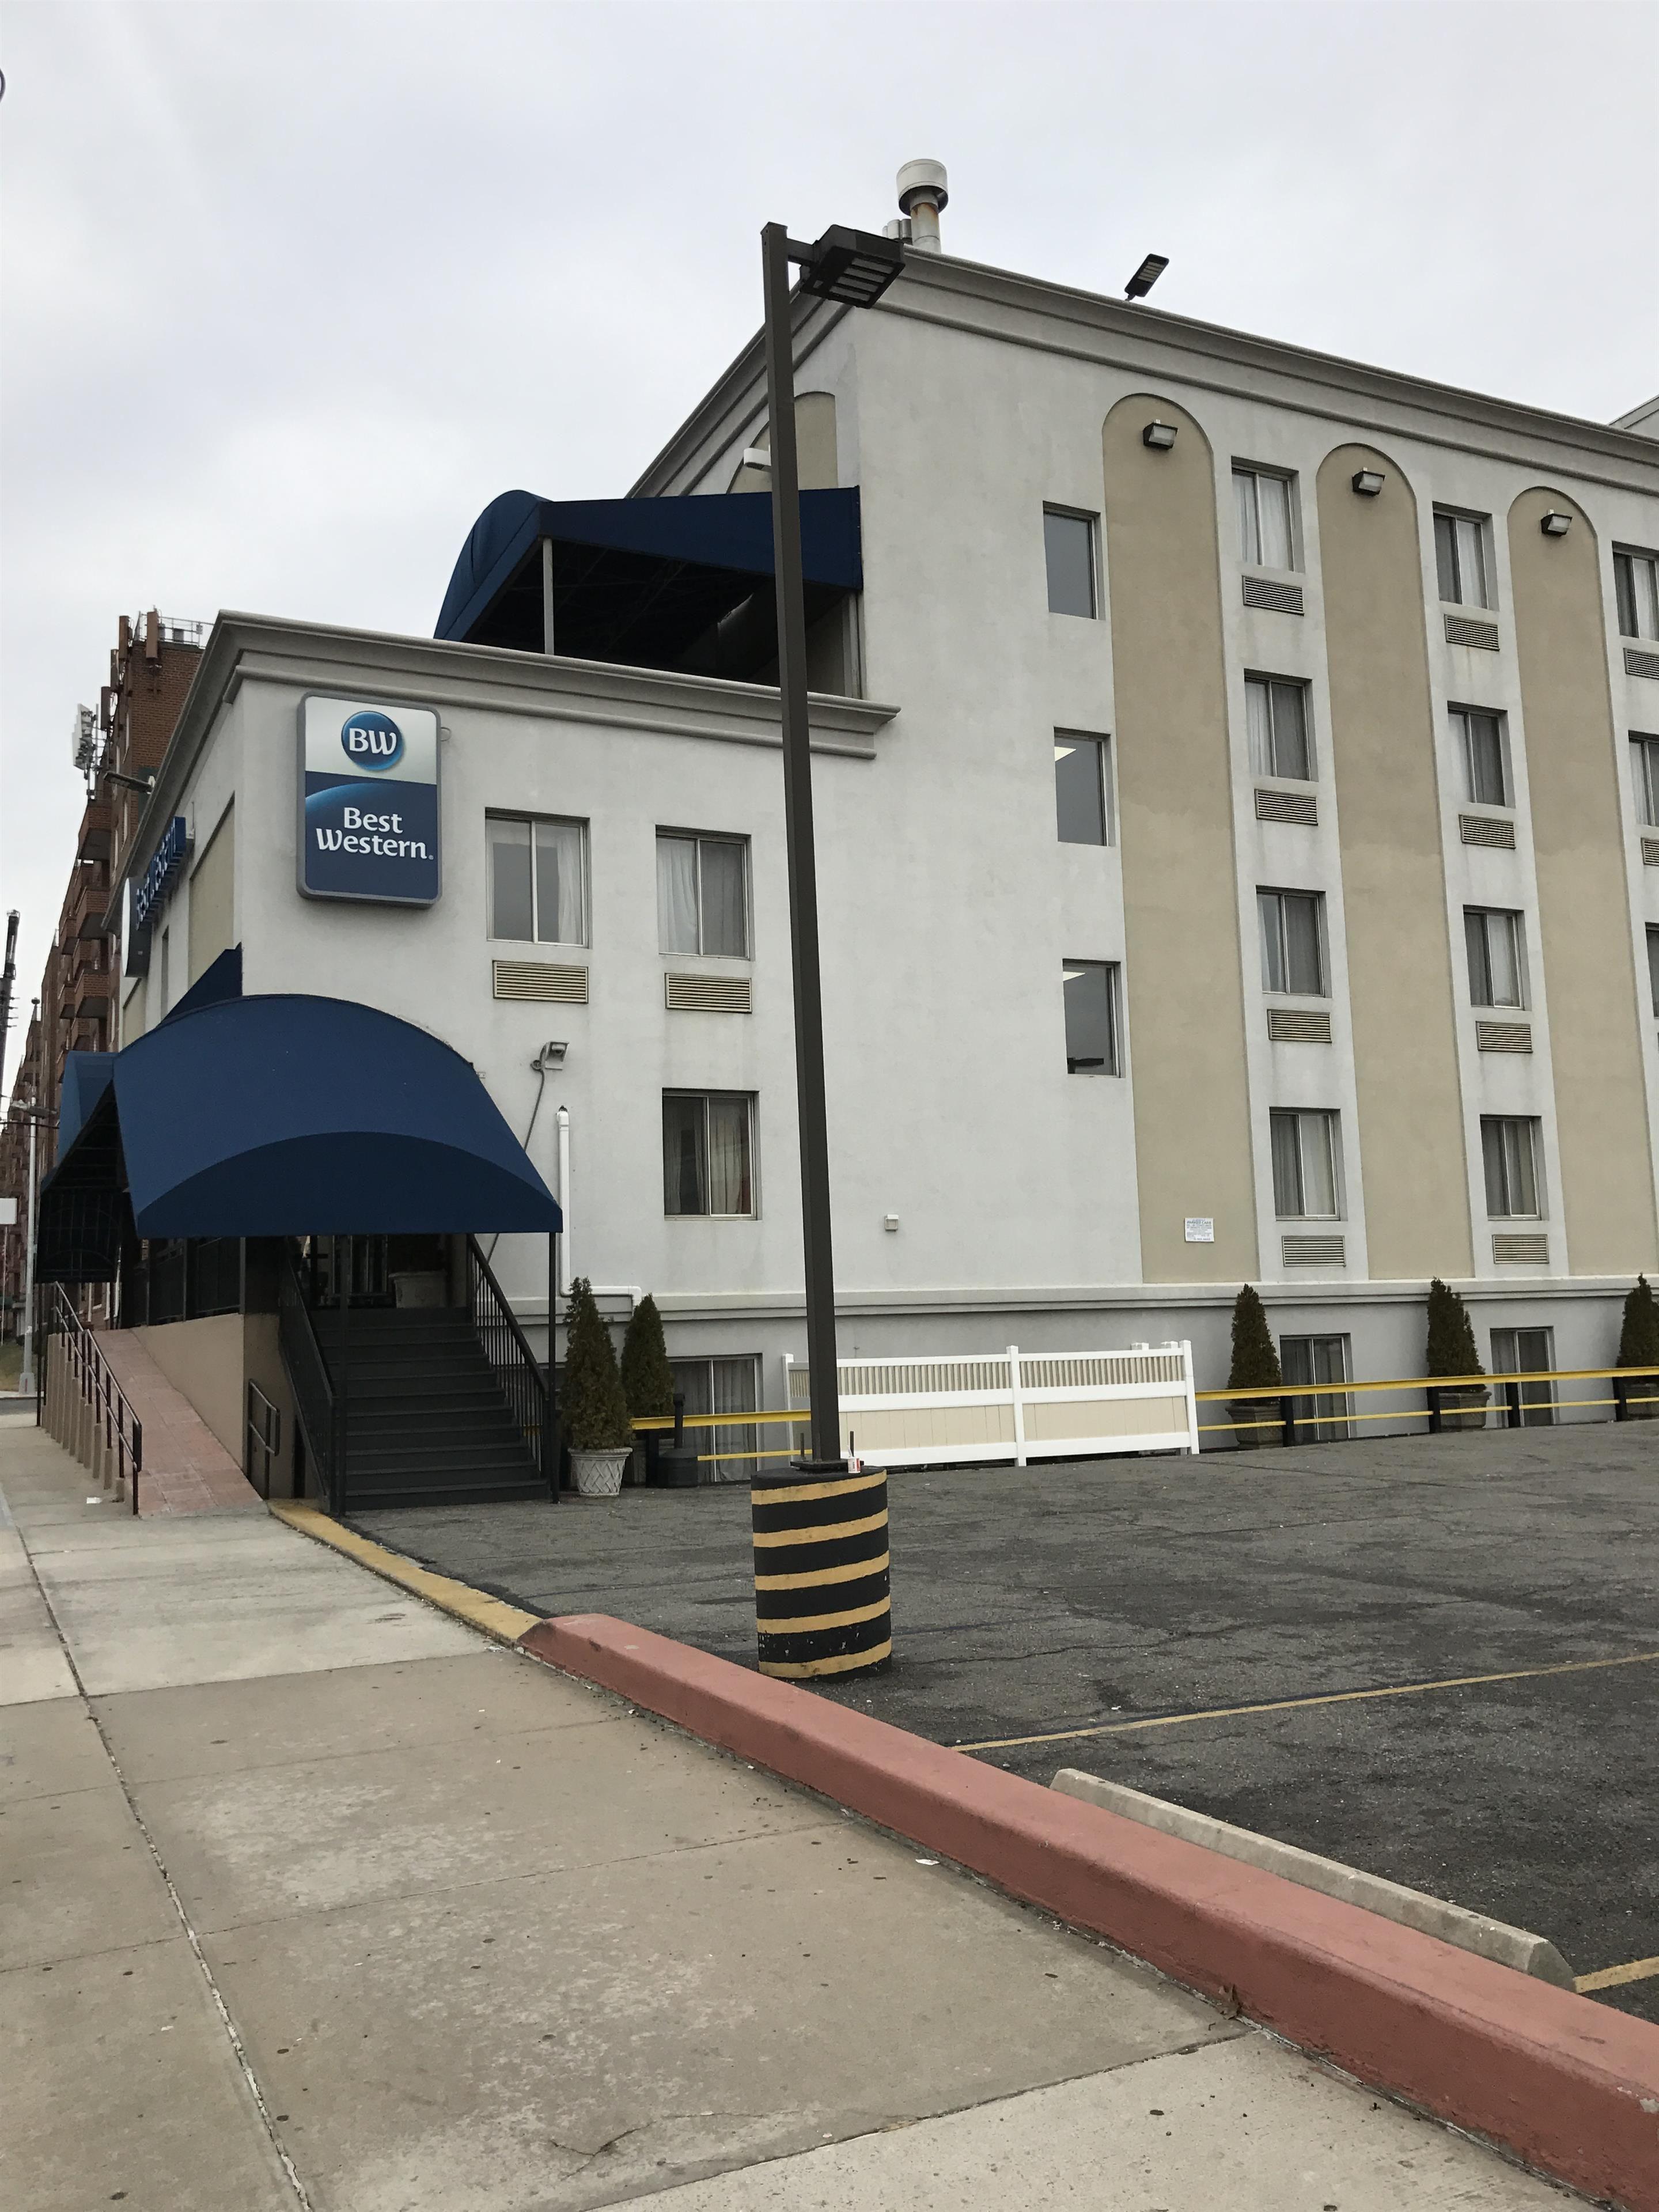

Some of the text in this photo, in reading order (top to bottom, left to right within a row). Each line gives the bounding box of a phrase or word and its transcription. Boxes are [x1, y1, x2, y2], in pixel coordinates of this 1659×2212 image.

[349, 728, 397, 756] BW
[343, 806, 403, 834] Best
[316, 828, 427, 860] Western
